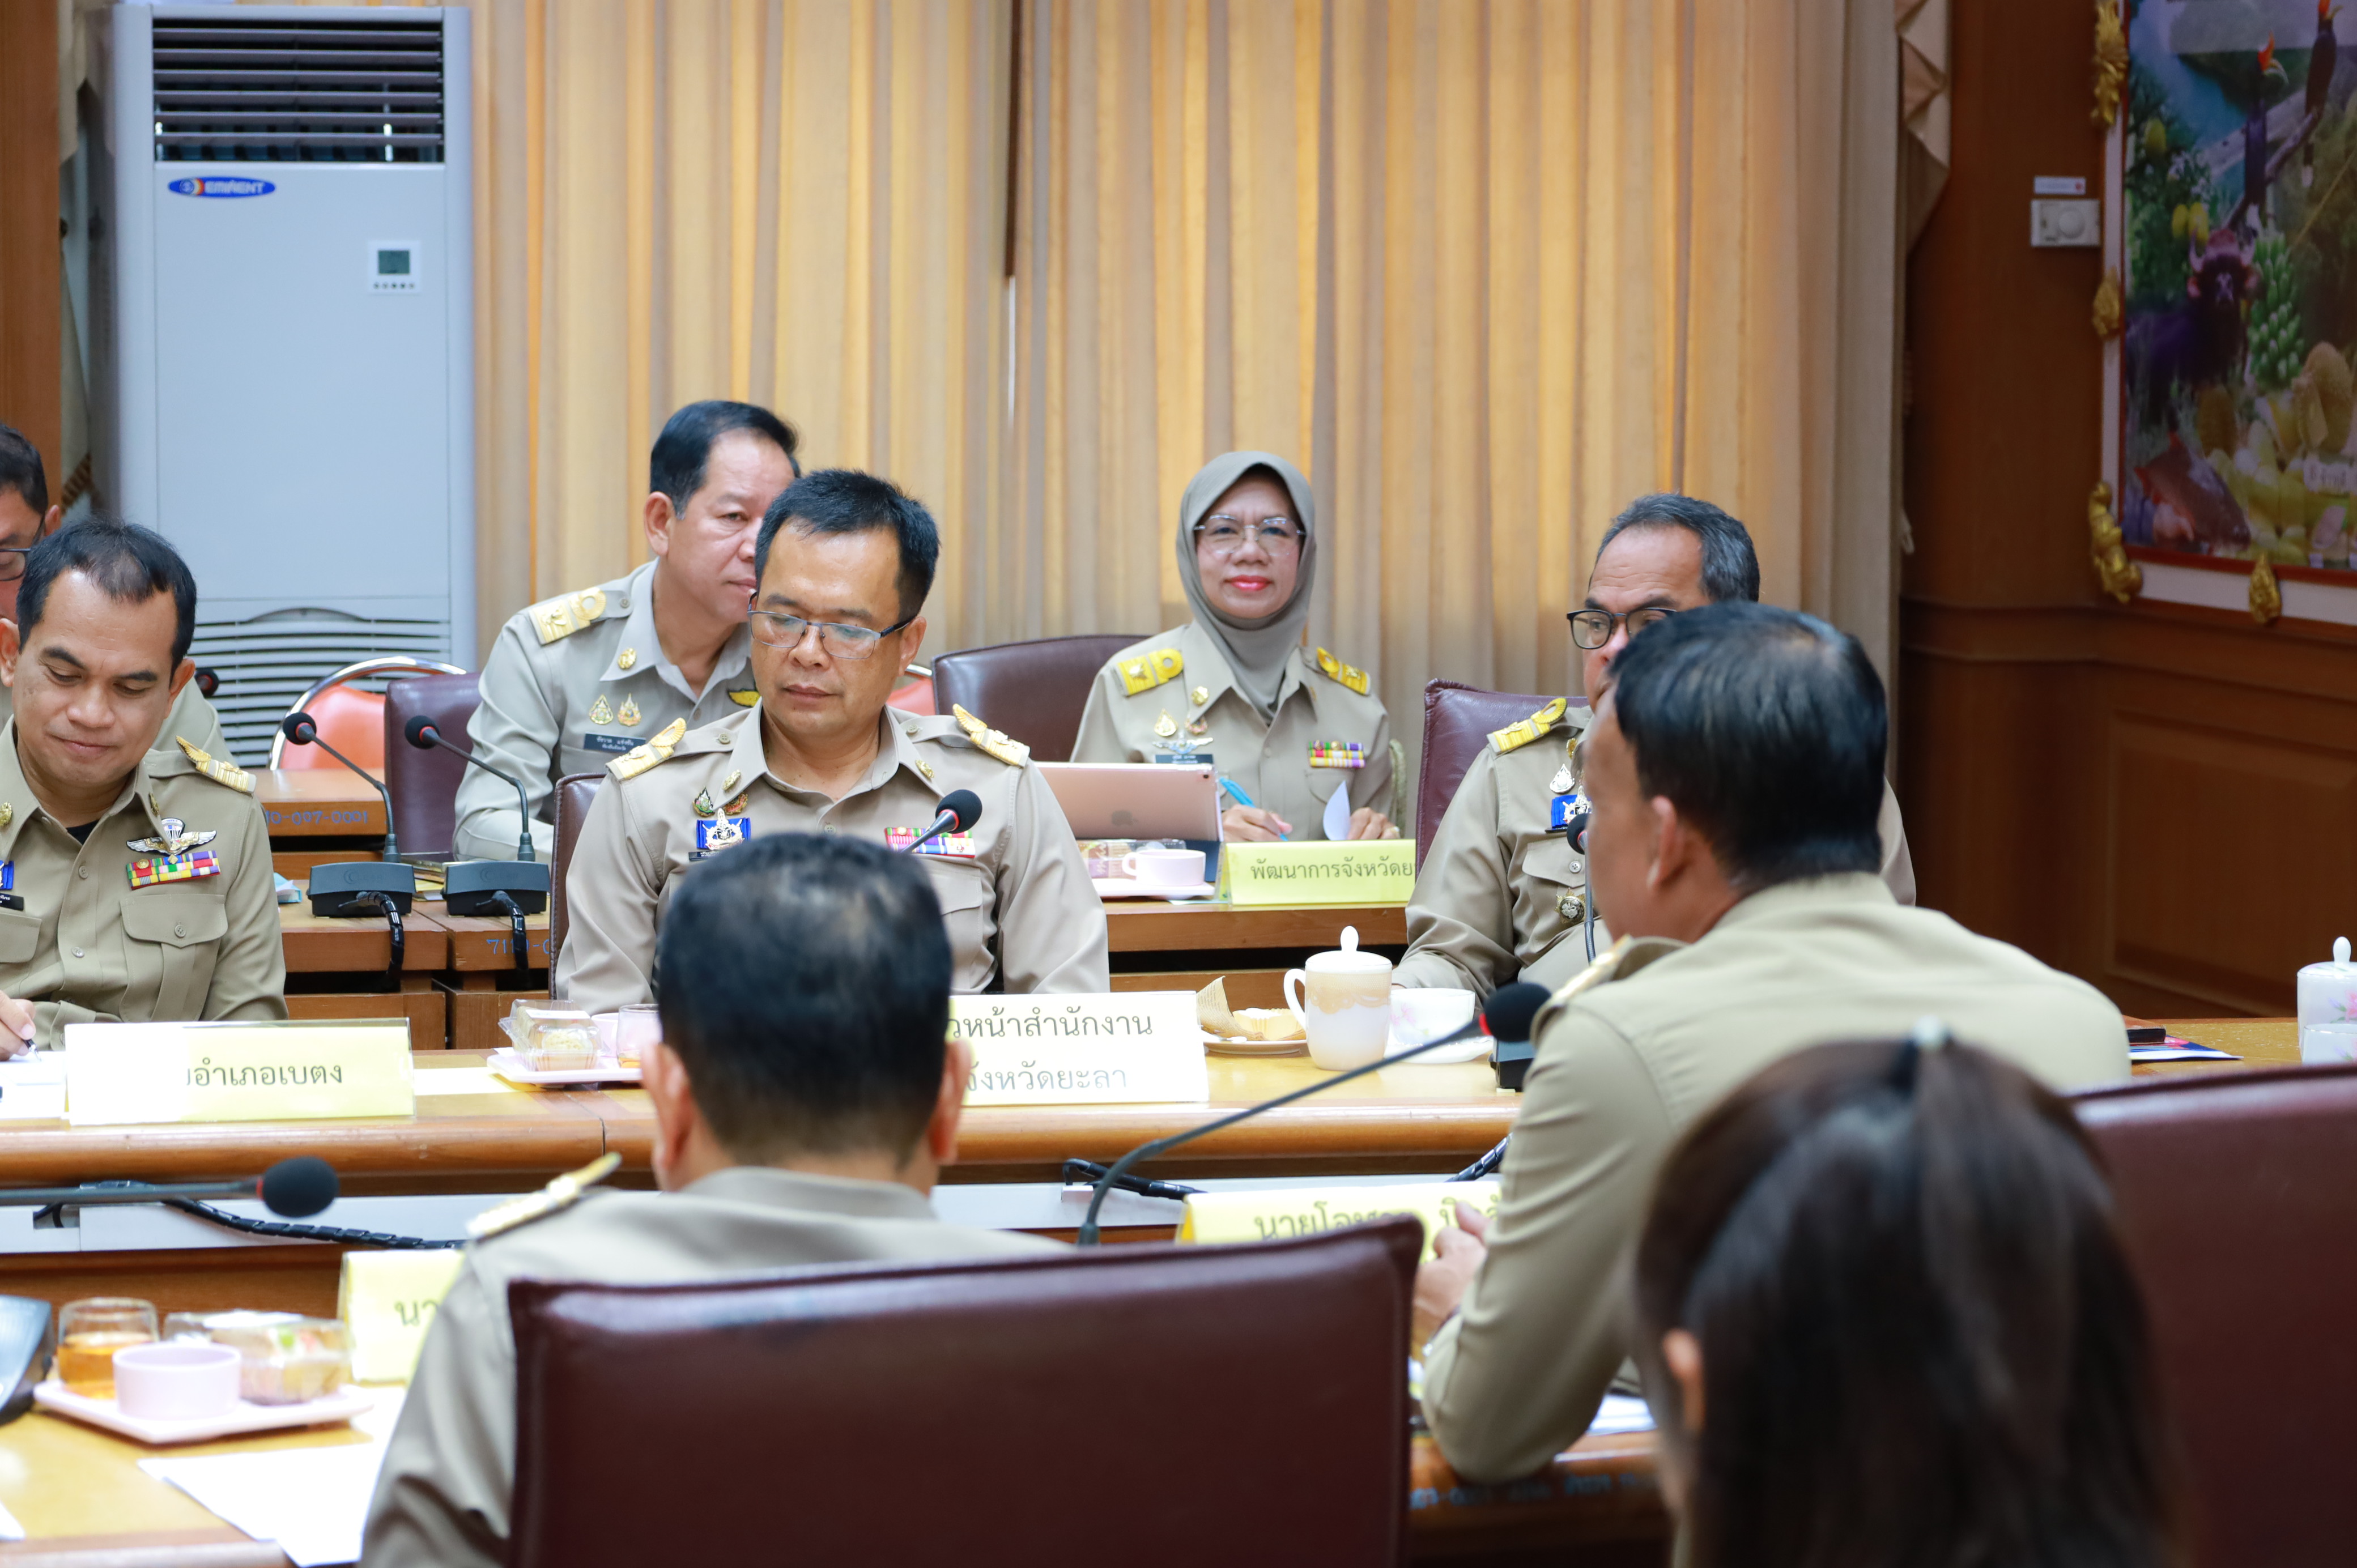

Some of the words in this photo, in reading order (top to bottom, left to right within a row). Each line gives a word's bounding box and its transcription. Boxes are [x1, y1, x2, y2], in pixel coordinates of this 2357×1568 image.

[1250, 855, 1416, 880] พัฒนาการจังหวัดย
